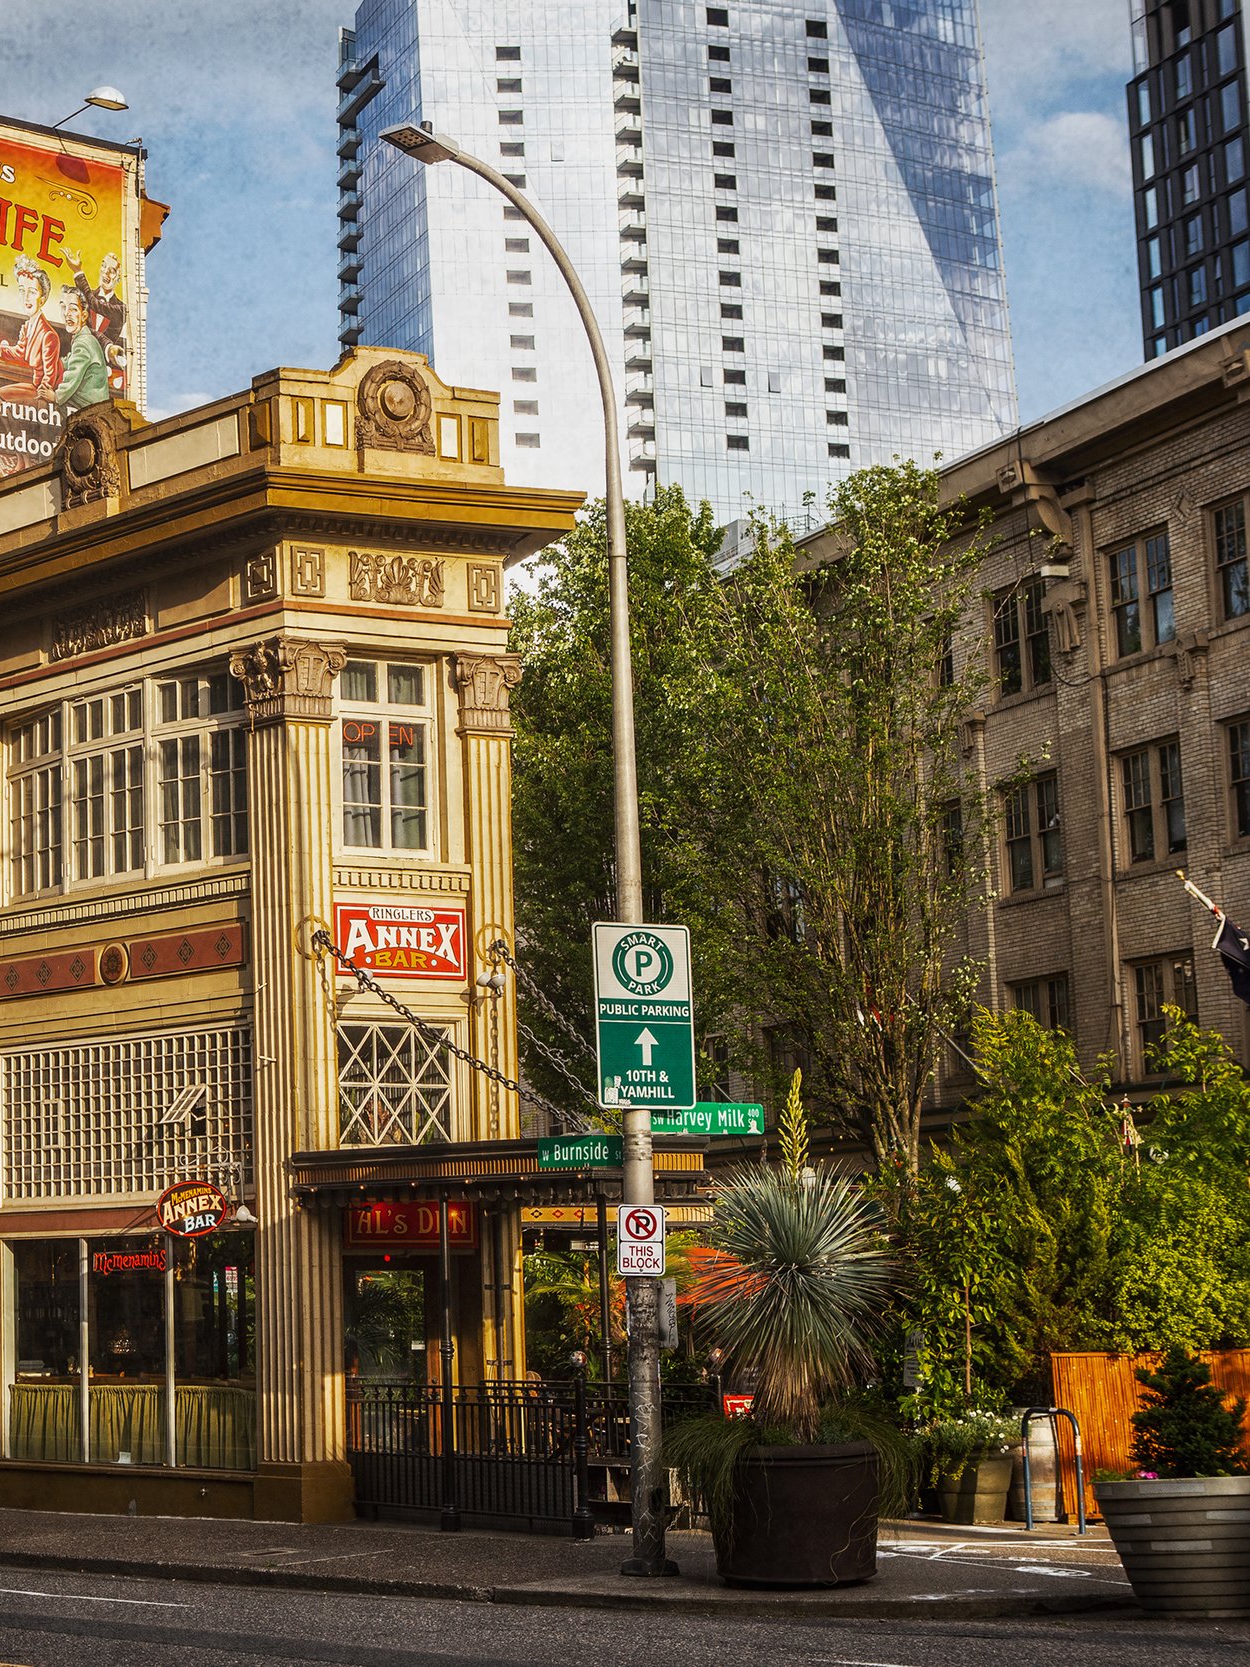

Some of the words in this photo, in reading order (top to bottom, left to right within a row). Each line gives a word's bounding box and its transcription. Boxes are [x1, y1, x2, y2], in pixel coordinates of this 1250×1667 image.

[372, 907, 433, 922] RINGLERS
[344, 919, 460, 968] ANNEX
[619, 932, 665, 952] SMART
[374, 950, 428, 969] BAR
[634, 950, 653, 977] P
[628, 981, 662, 995] PARK
[599, 1004, 639, 1016] PUBLIC
[641, 1005, 689, 1017] PARKING
[626, 1070, 656, 1082] 10TH
[659, 1070, 669, 1082] &
[621, 1085, 675, 1099] YAMHILL
[652, 1113, 664, 1125] SW
[667, 1109, 712, 1131] Harvey
[718, 1109, 745, 1127] Milk
[747, 1108, 760, 1117] 400
[542, 1150, 549, 1161] W
[554, 1142, 609, 1160] Burnside
[162, 1194, 223, 1227] ANNEX
[184, 1213, 218, 1233] BAR
[628, 1246, 654, 1257] THIS
[622, 1257, 661, 1269] BLOCK
